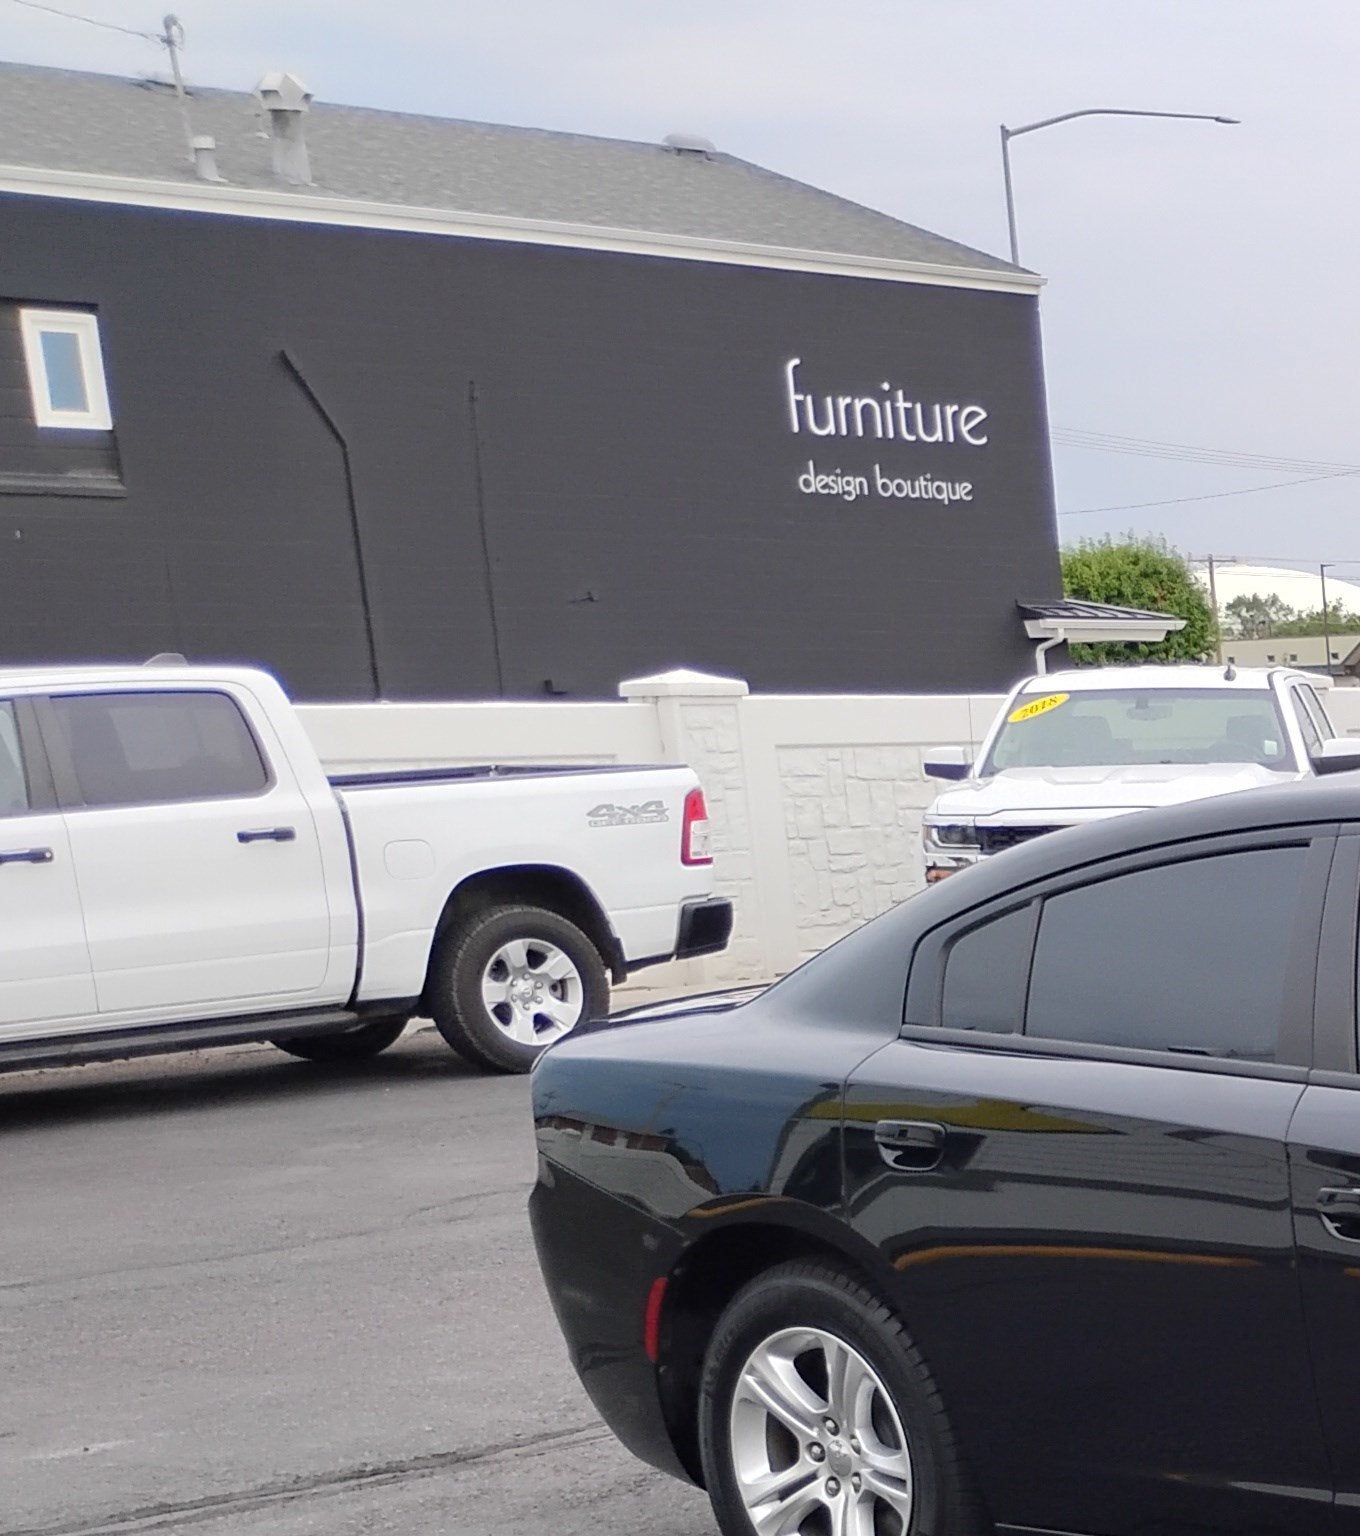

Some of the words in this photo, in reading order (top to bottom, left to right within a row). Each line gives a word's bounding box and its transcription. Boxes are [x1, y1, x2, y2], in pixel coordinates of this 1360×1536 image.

[787, 357, 988, 445] furniture
[799, 459, 868, 501] design
[874, 463, 973, 505] boutique
